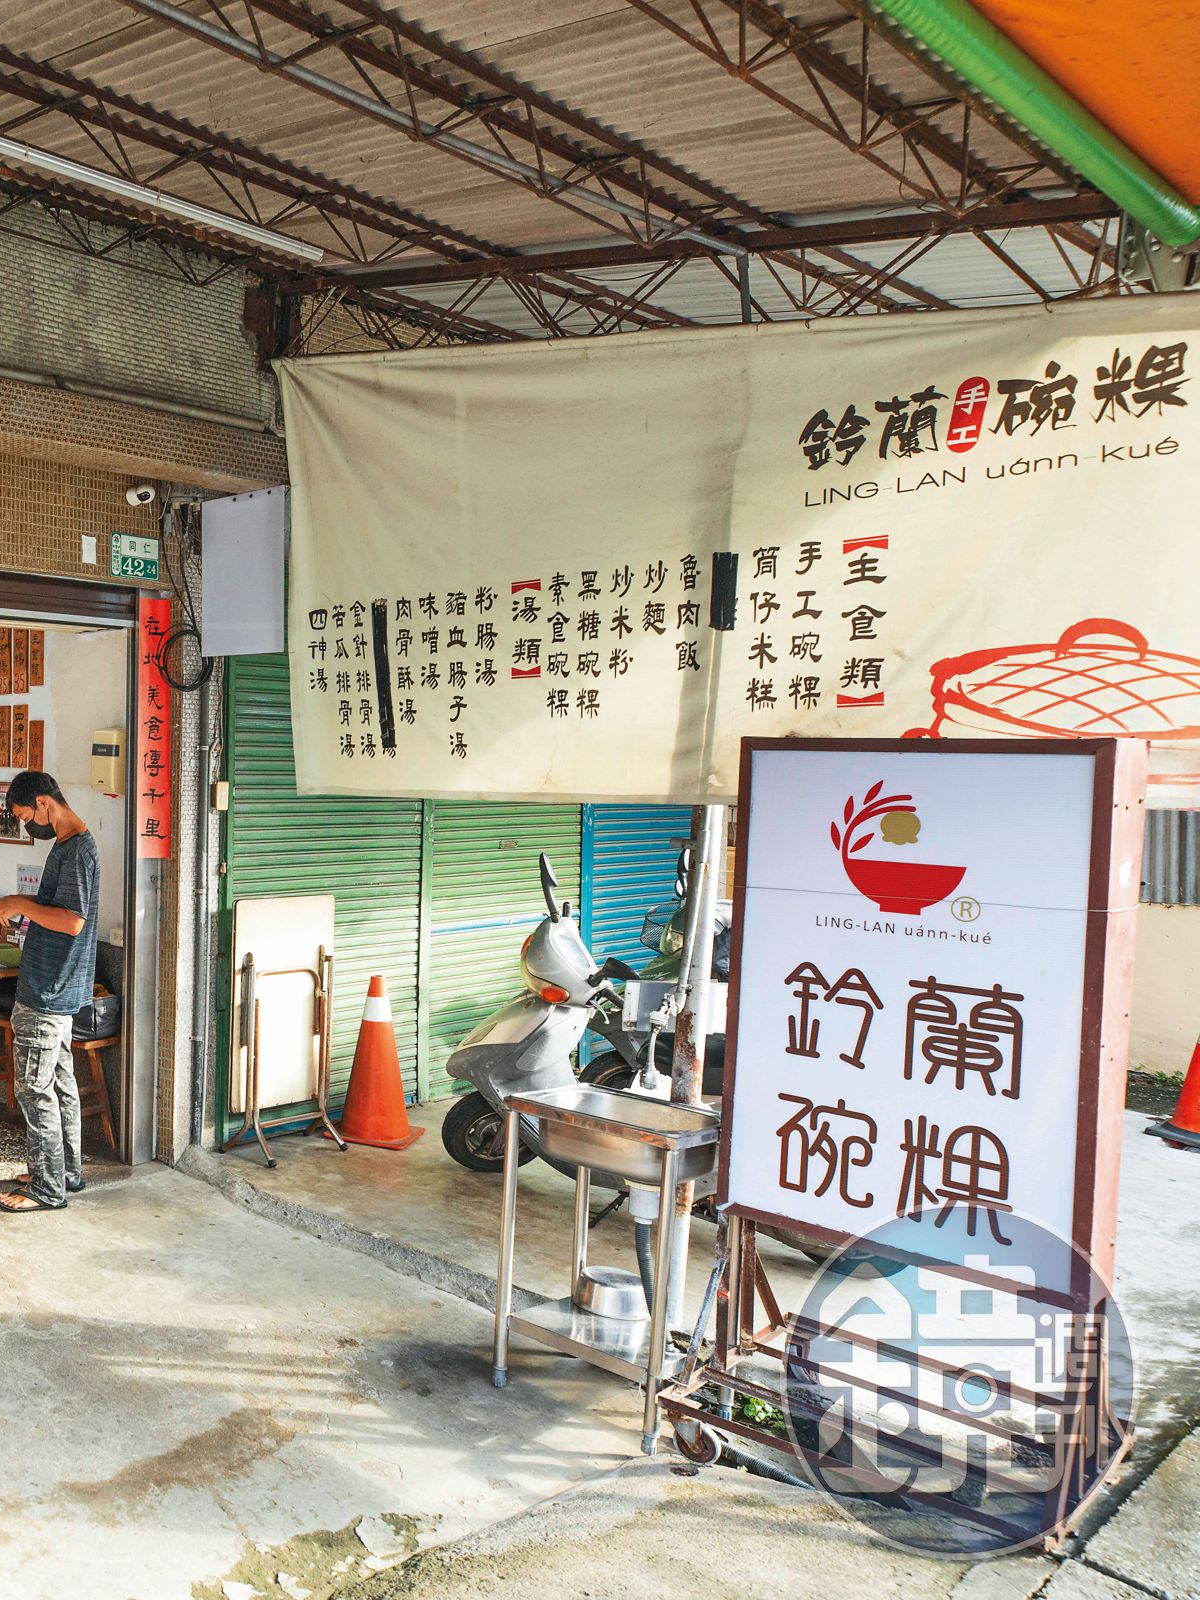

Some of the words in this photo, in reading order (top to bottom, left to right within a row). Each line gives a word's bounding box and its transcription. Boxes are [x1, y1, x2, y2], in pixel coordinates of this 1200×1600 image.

[798, 385, 948, 471] 鈴蘭
[947, 383, 987, 446] 手工
[988, 341, 1192, 437] 碗粿
[804, 465, 966, 508] LING-LAN
[122, 557, 145, 577] 42
[608, 565, 634, 678] 炒米粉
[642, 560, 668, 635] 炒麵
[745, 546, 781, 712] 筒仔米糕
[788, 541, 823, 710] 手工碗粿
[308, 608, 328, 693] 四神湯
[331, 604, 356, 759] 苦瓜排骨湯
[349, 600, 377, 759] 金針排骨湯
[395, 597, 417, 725] 肉骨酥湯
[418, 592, 441, 690] 味噌湯
[445, 591, 468, 760] 豬血腸子湯
[474, 586, 498, 687] 粉腸湯
[546, 571, 570, 719] 素食碗粿
[576, 571, 602, 719] 黑糖碗粿
[814, 914, 896, 936] LING-LAN
[904, 923, 993, 945] uánn-kué
[783, 960, 1025, 1100] 鈴蘭
[775, 1092, 1014, 1247] 碗粿
